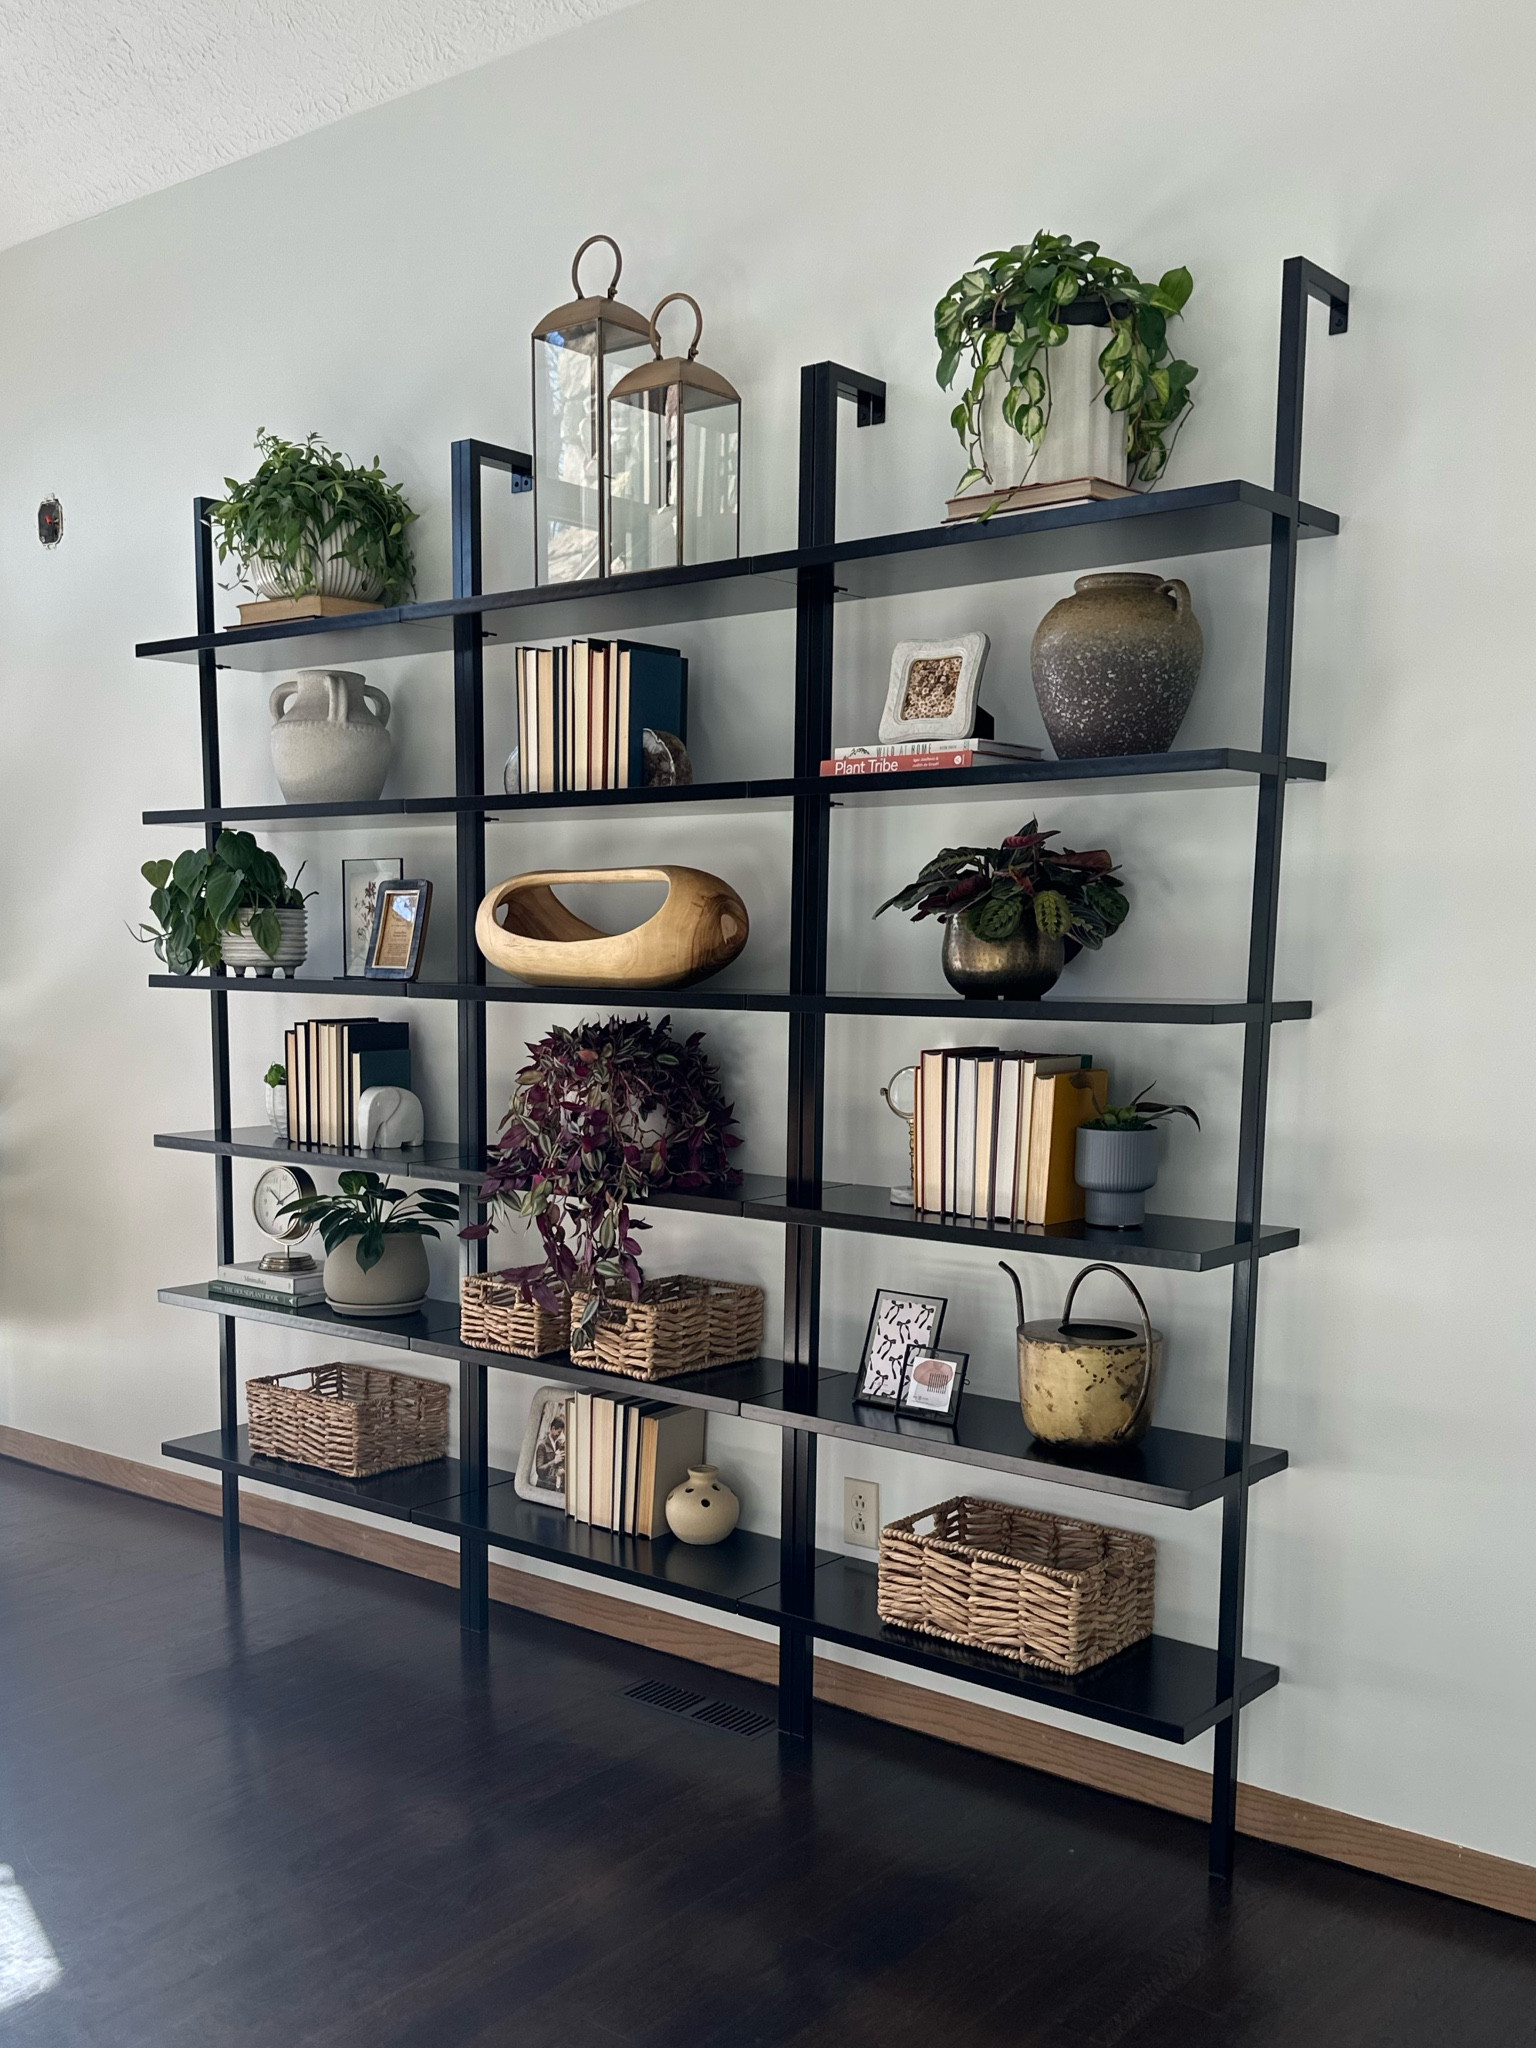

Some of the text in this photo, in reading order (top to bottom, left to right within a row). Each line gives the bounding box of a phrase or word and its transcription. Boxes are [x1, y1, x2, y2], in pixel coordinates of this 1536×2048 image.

[911, 743, 932, 755] HOME
[835, 758, 899, 775] Plant Tribe
[265, 1294, 279, 1302] BOOK
